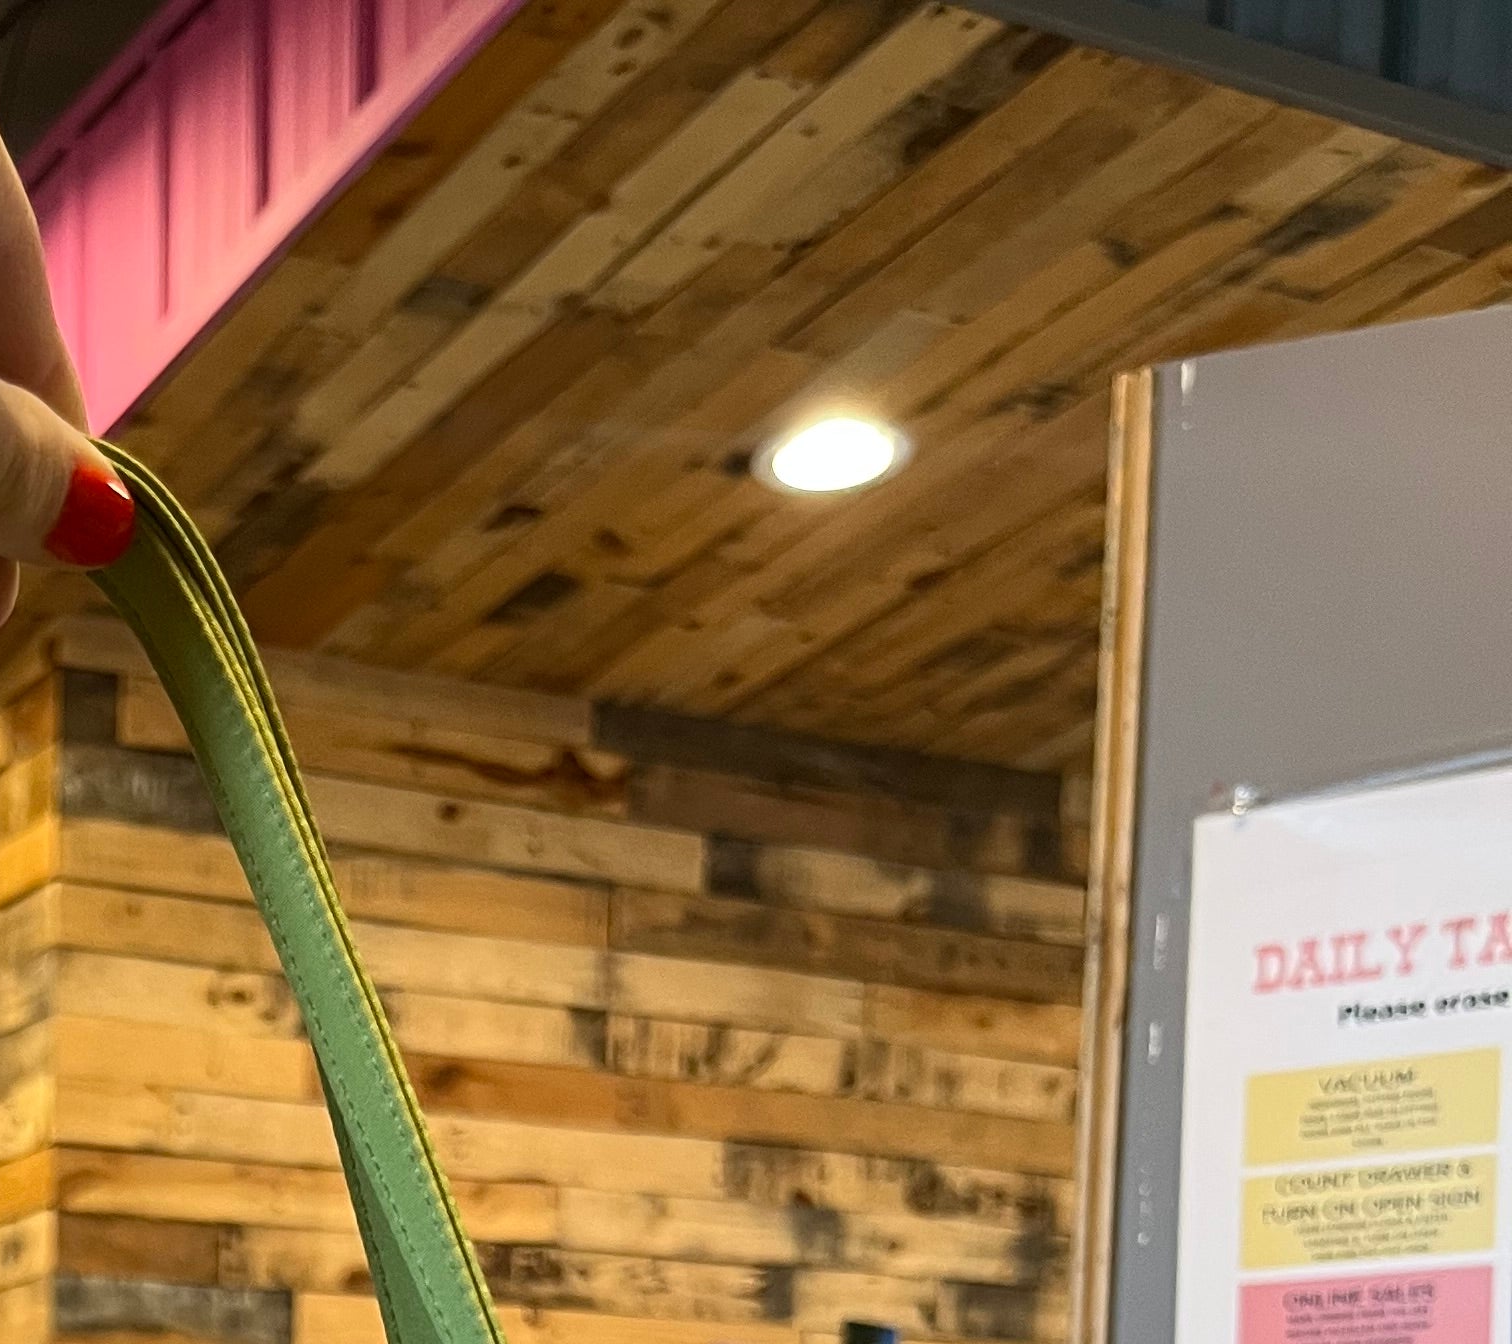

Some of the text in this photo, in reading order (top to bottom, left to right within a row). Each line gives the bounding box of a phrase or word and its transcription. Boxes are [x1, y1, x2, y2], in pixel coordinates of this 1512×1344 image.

[1251, 920, 1428, 995] DAILY
[1336, 1000, 1427, 1028] Please
[1317, 1067, 1416, 1095] VACUUM
[1275, 1172, 1355, 1197] COUNT
